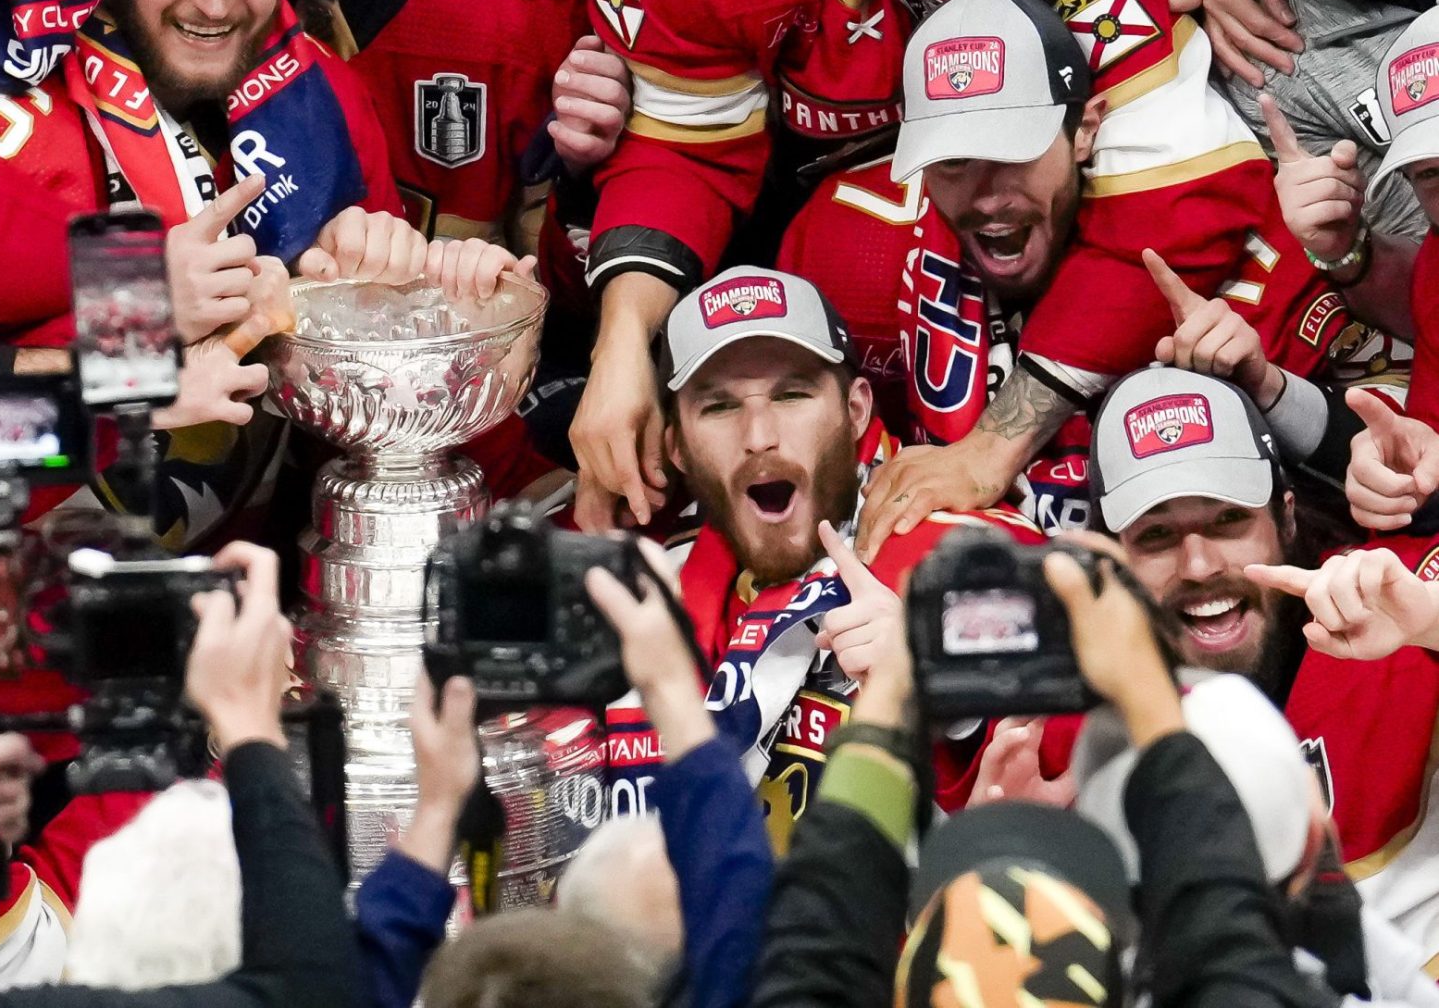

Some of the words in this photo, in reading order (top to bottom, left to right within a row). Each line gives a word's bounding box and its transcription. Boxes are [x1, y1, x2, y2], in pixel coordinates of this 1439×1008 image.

[937, 44, 967, 54] STANLEY
[970, 43, 986, 51] CUP
[928, 50, 999, 81] CHAMPIONS
[425, 100, 439, 109] 20
[462, 102, 476, 111] 24
[704, 285, 782, 316] CHAMPIONS
[1129, 405, 1208, 444] CHAMPIONS
